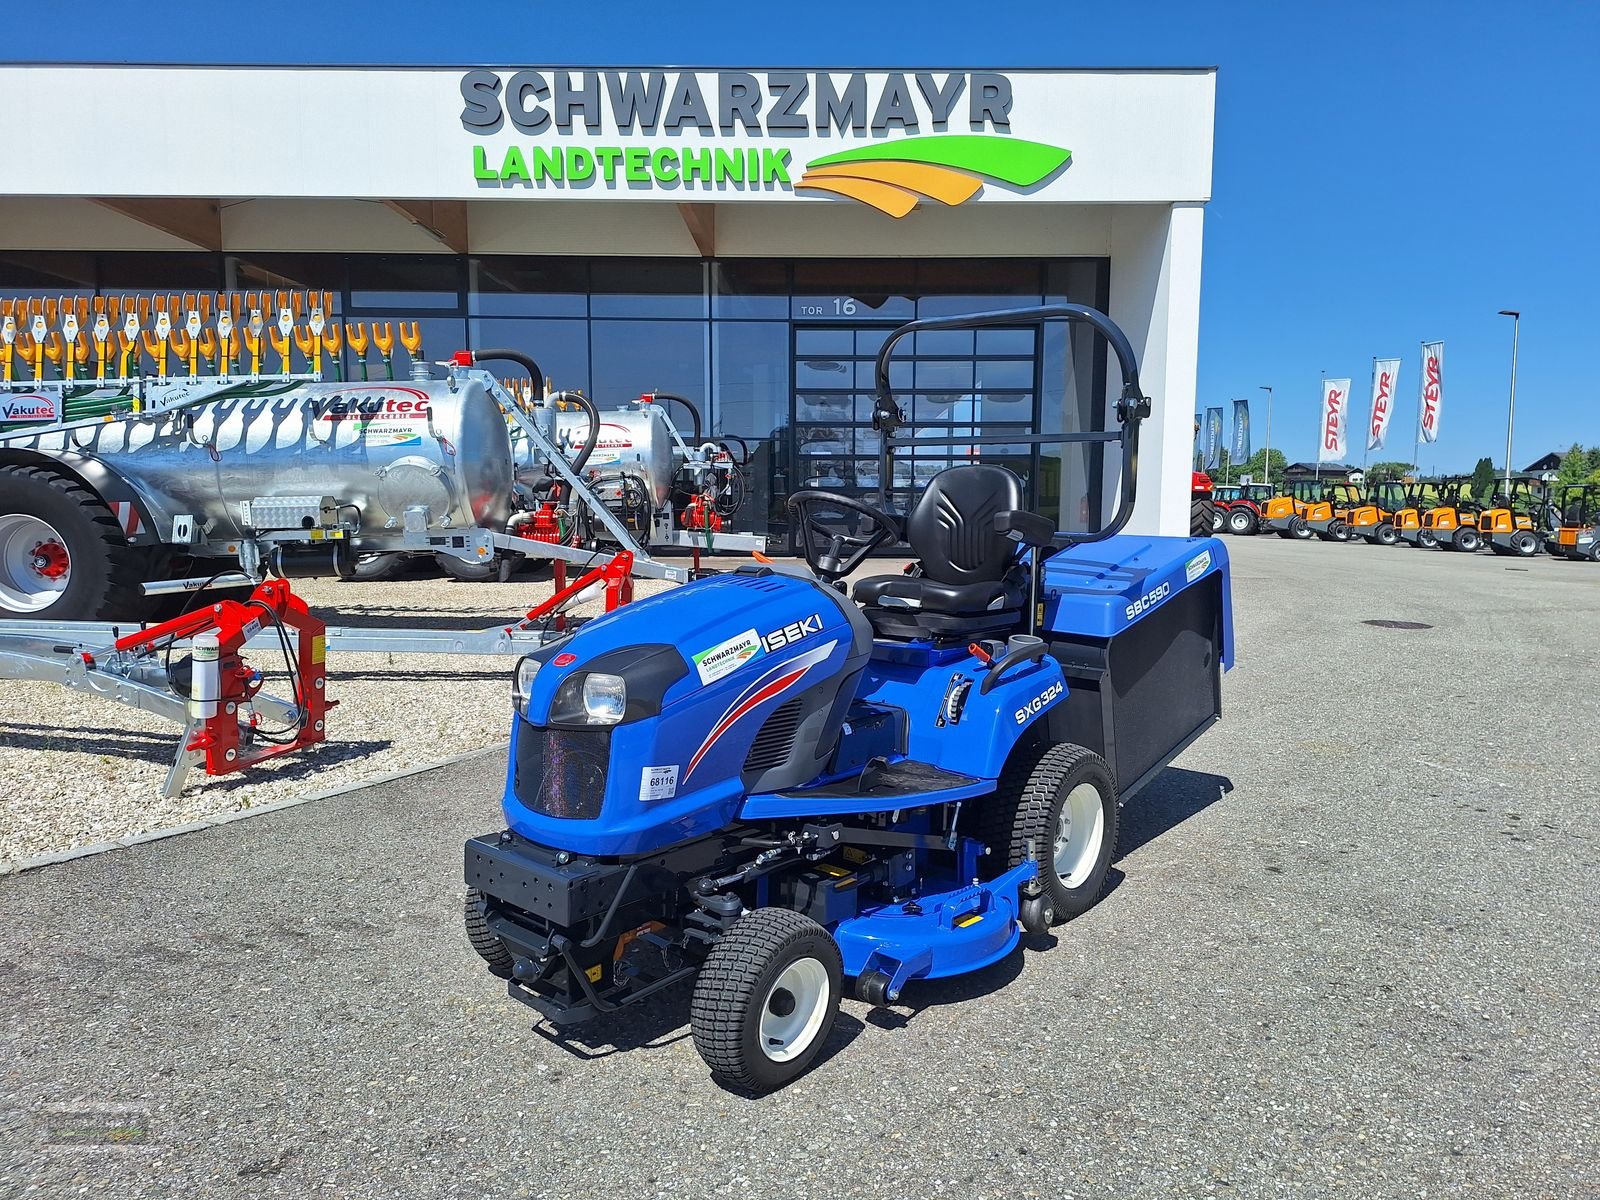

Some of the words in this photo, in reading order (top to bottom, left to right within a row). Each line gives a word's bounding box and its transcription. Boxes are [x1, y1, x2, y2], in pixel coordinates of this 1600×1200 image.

[459, 69, 1013, 136] SCHWARZMAYR
[472, 145, 791, 183] LANDTECHNIK
[801, 306, 823, 315] TOR
[833, 298, 856, 315] 16
[2, 403, 54, 419] Vakutec
[311, 395, 429, 421] Vakutec
[1372, 371, 1391, 438] STEYR
[1422, 356, 1440, 431] STEYR
[1325, 389, 1342, 451] STEYR
[1125, 581, 1170, 621] SBC590
[702, 639, 752, 667] SCHWARZMAYR
[760, 613, 823, 653] ISEKI
[1014, 680, 1064, 725] SXG324
[650, 776, 674, 786] 68116
